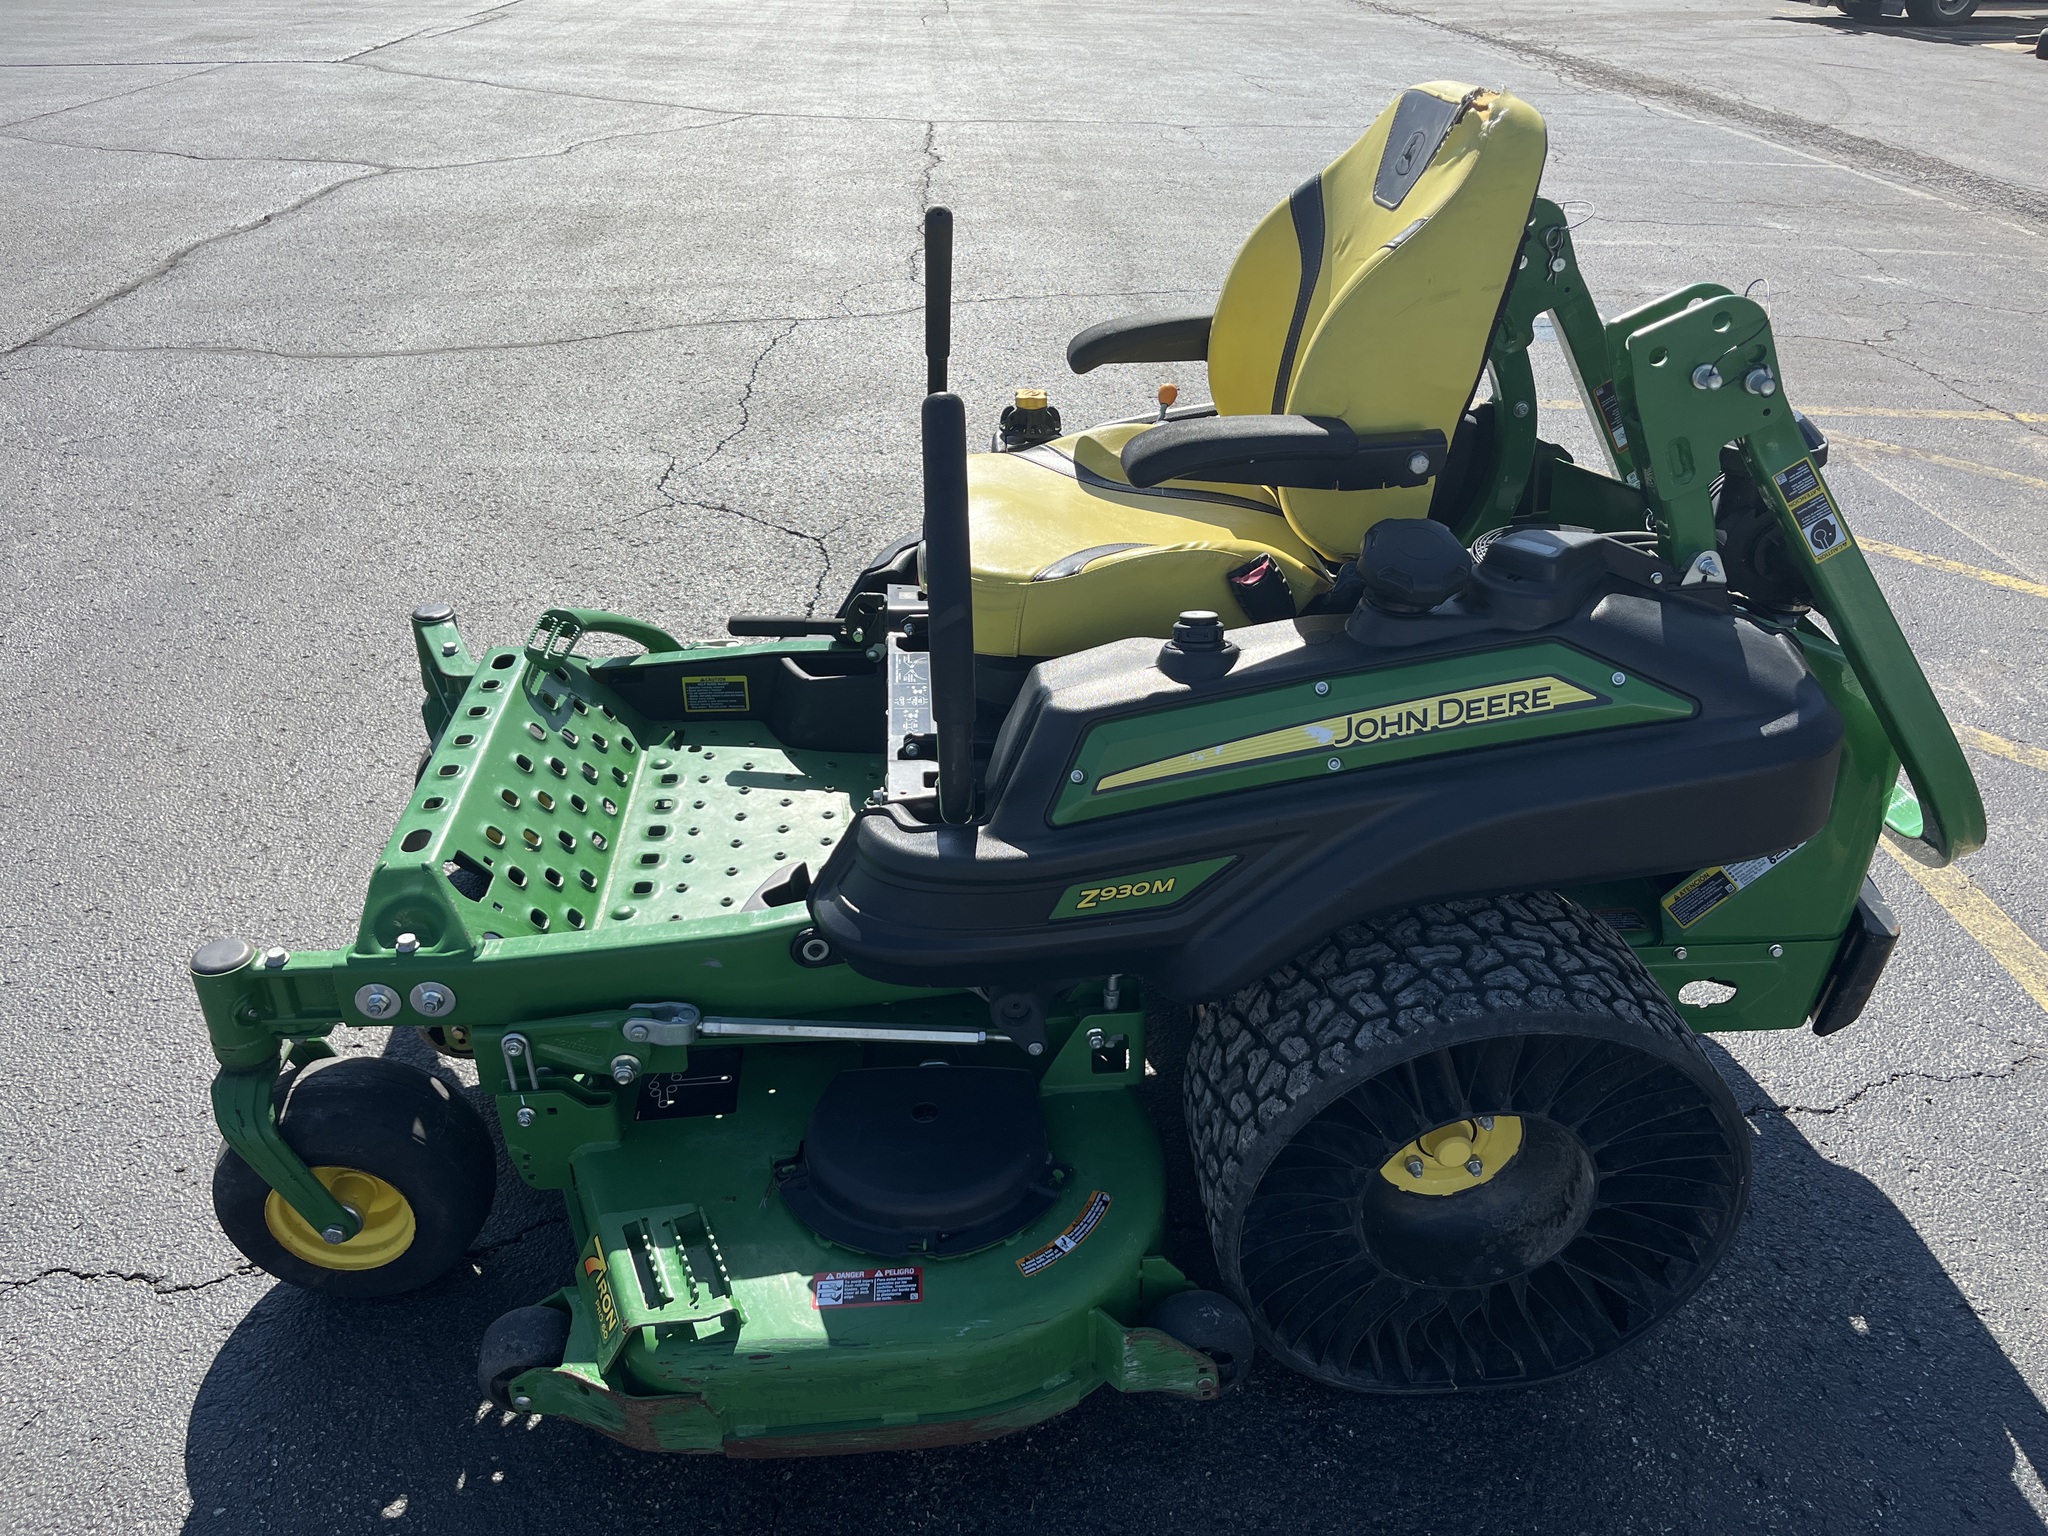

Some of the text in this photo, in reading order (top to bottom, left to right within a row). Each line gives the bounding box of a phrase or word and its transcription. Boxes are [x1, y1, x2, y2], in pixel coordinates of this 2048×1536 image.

[1334, 685, 1554, 746] JOHN DEERE
[1076, 877, 1176, 909] Z930M
[836, 1271, 864, 1279] DANGER
[885, 1268, 914, 1276] PELIGRO
[595, 1271, 617, 1332] IRON
